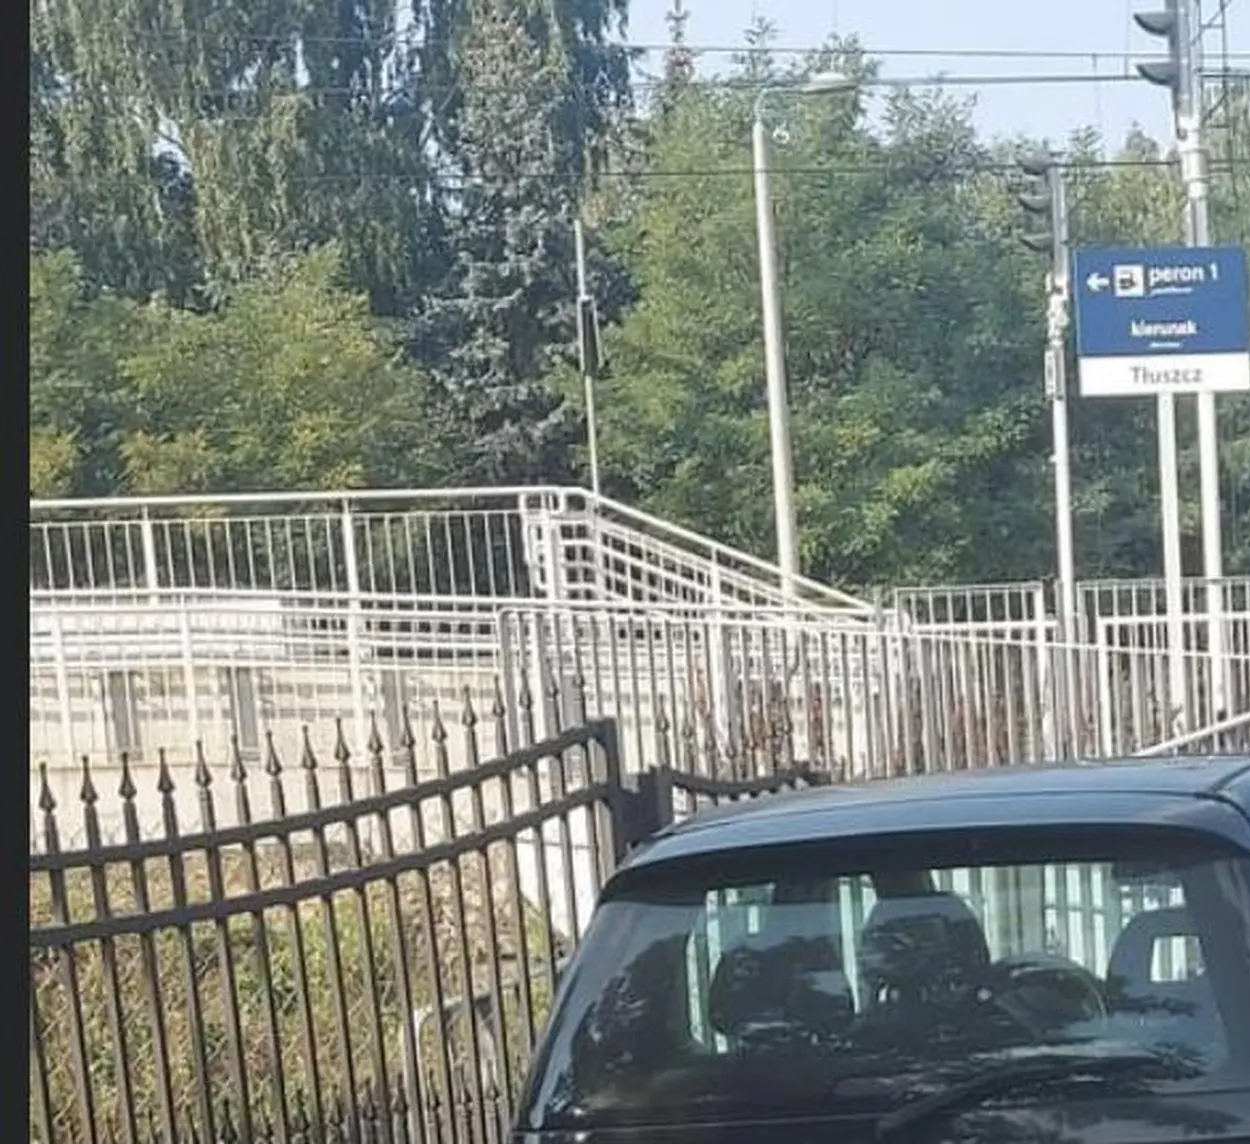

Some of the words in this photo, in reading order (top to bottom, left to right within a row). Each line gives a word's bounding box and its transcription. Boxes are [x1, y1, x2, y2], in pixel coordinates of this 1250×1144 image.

[1149, 264, 1204, 287] peron
[1209, 262, 1219, 281] 1
[1131, 319, 1198, 337] kierunek
[1130, 366, 1203, 385] Tłuszcz
